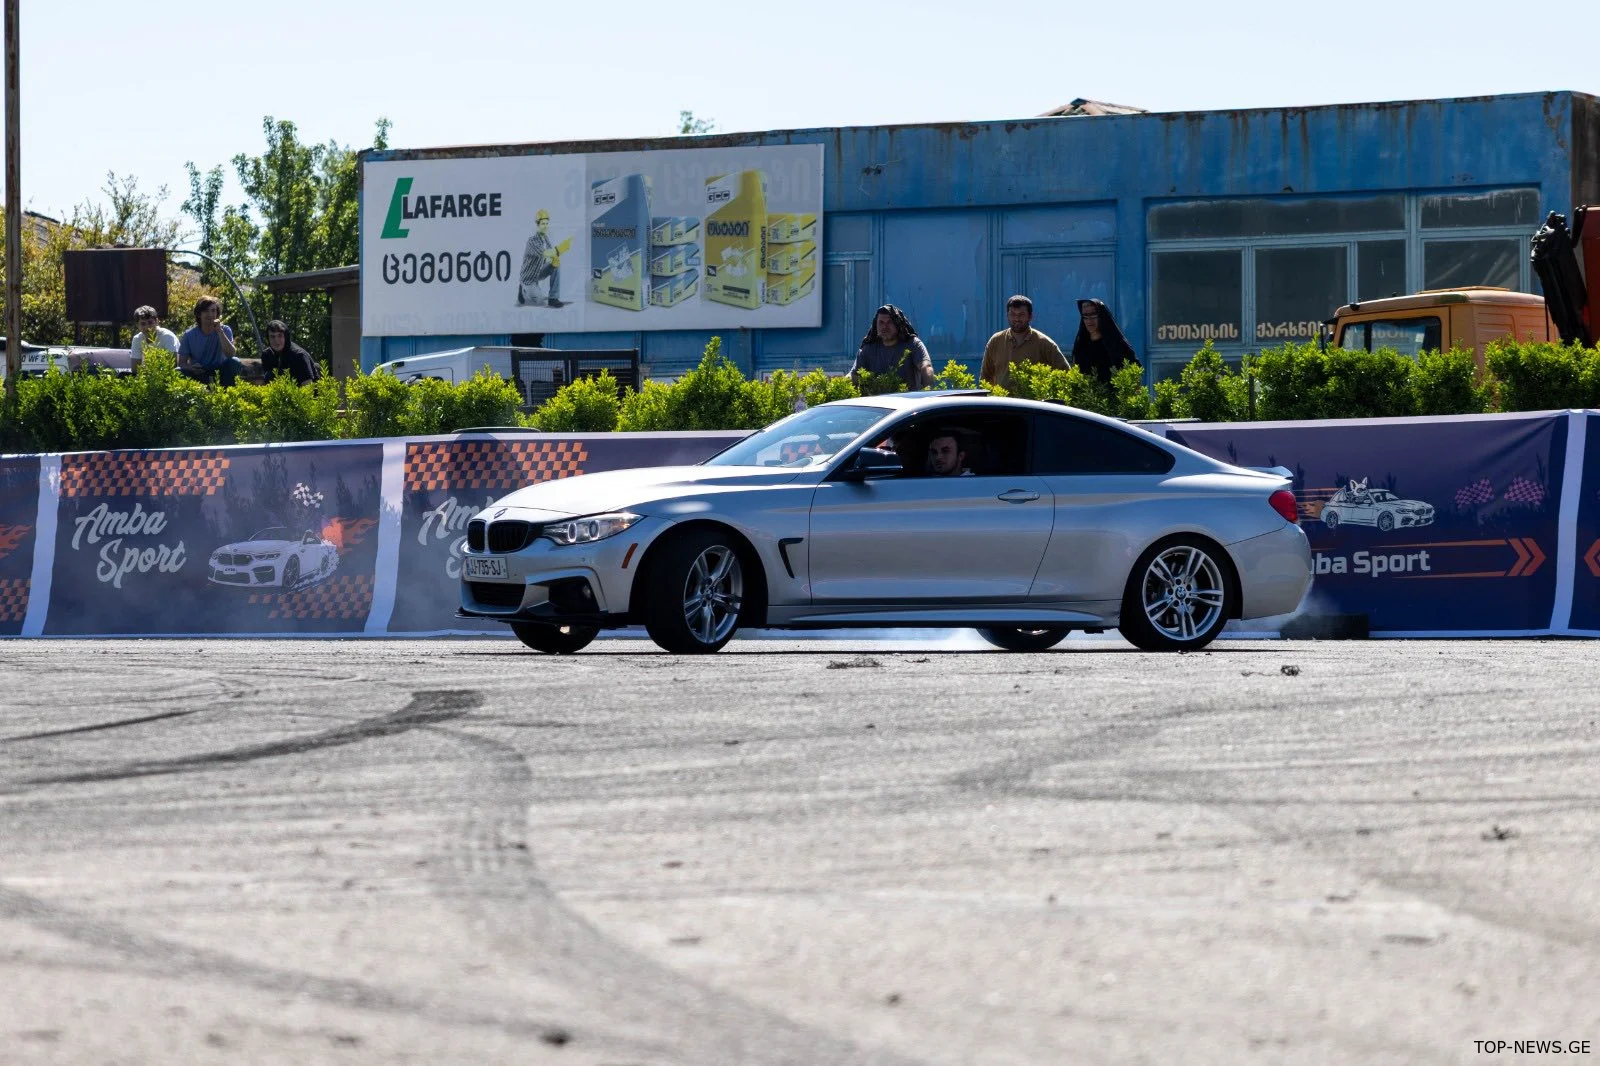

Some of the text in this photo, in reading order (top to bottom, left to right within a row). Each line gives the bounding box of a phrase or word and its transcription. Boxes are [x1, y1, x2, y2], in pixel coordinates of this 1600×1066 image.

[402, 193, 502, 219] LAFARGE
[382, 250, 511, 285] ცემენტი
[1157, 322, 1239, 341] ქუთაისის
[71, 502, 168, 551] Amba
[96, 538, 187, 590] Sport
[1353, 550, 1431, 578] Sport
